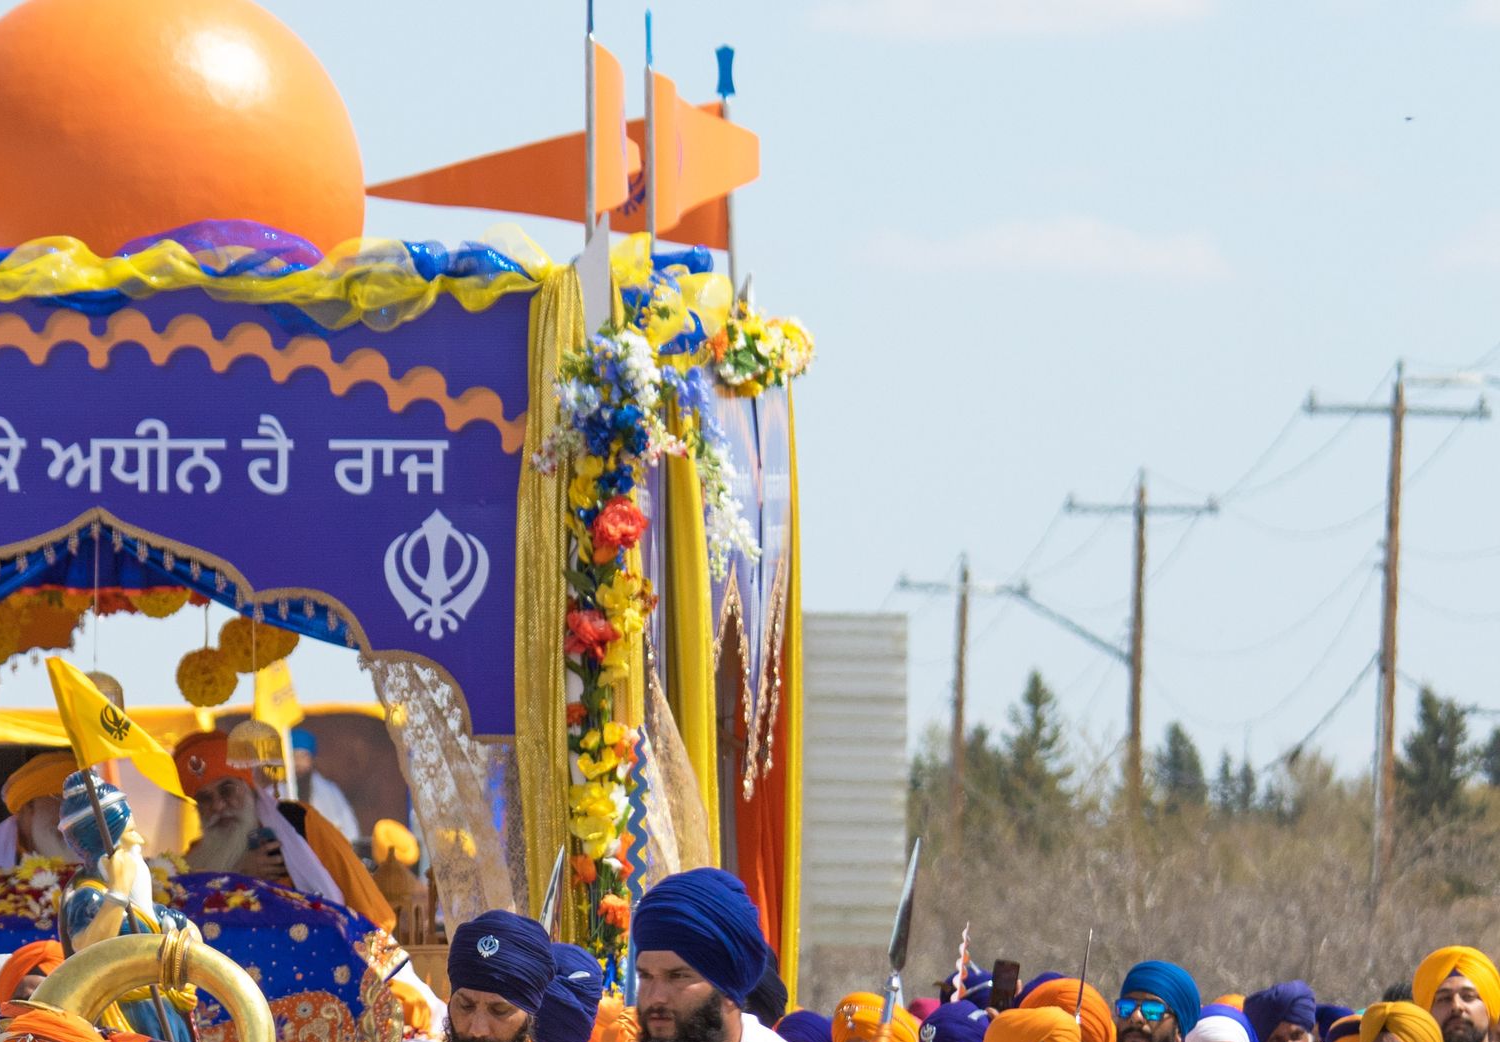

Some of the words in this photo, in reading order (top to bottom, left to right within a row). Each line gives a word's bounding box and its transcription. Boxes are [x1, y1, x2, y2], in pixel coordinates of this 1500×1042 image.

[41, 418, 227, 494] ਅਧੀਨ
[241, 413, 295, 495] ਹੈ
[328, 439, 450, 495] ਰਾਜ
